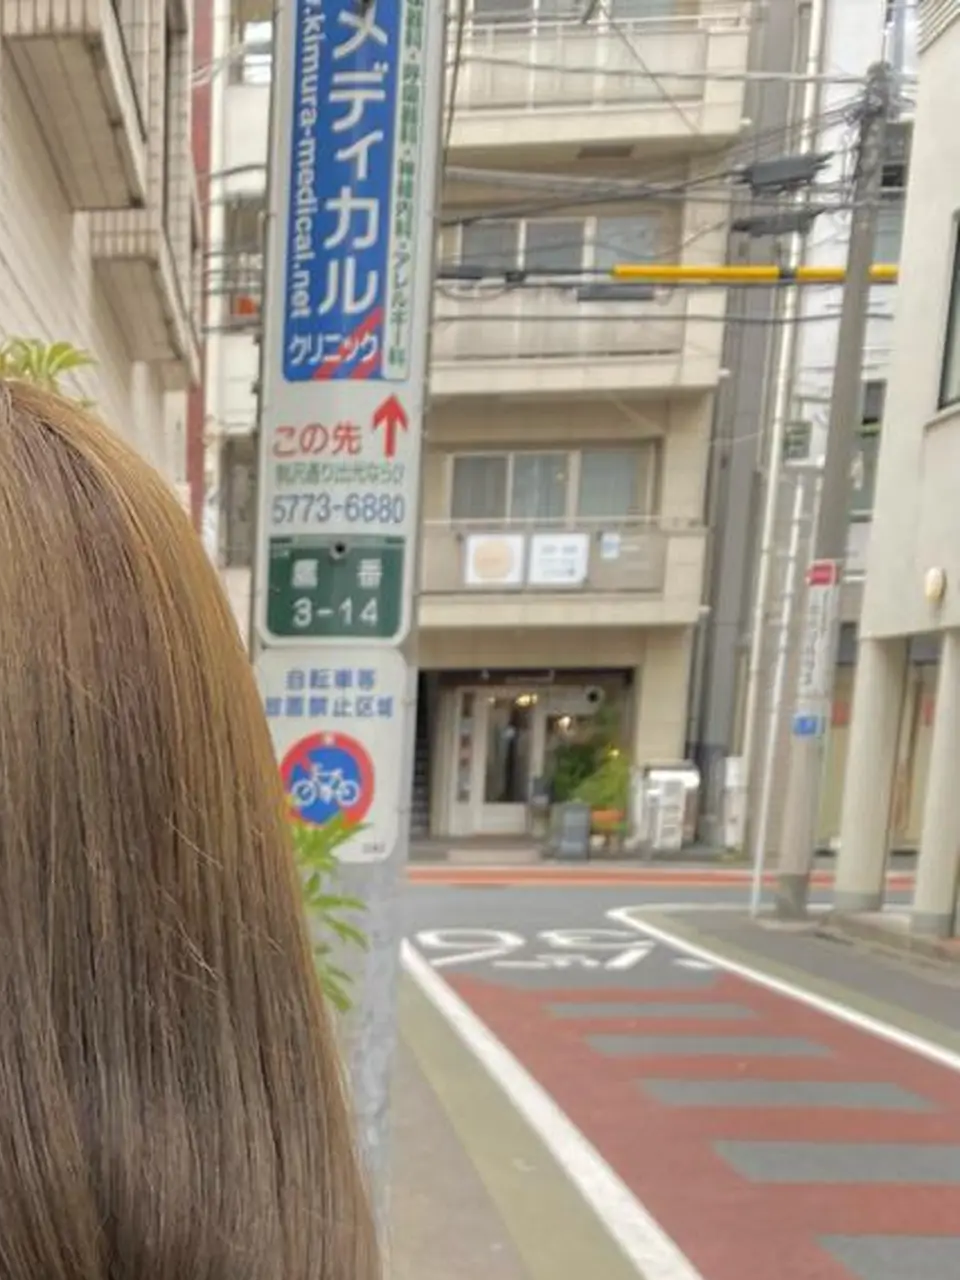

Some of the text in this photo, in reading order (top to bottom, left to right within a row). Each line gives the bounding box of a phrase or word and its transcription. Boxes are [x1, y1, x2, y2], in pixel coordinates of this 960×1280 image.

[290, 0, 327, 319] .kimura-medical.net
[318, 0, 389, 316] メディカル
[288, 331, 378, 365] クリニック
[272, 420, 363, 458] この先
[271, 492, 406, 524] 5773-6880
[292, 596, 379, 628] 3-14
[286, 667, 376, 691] 自転車等
